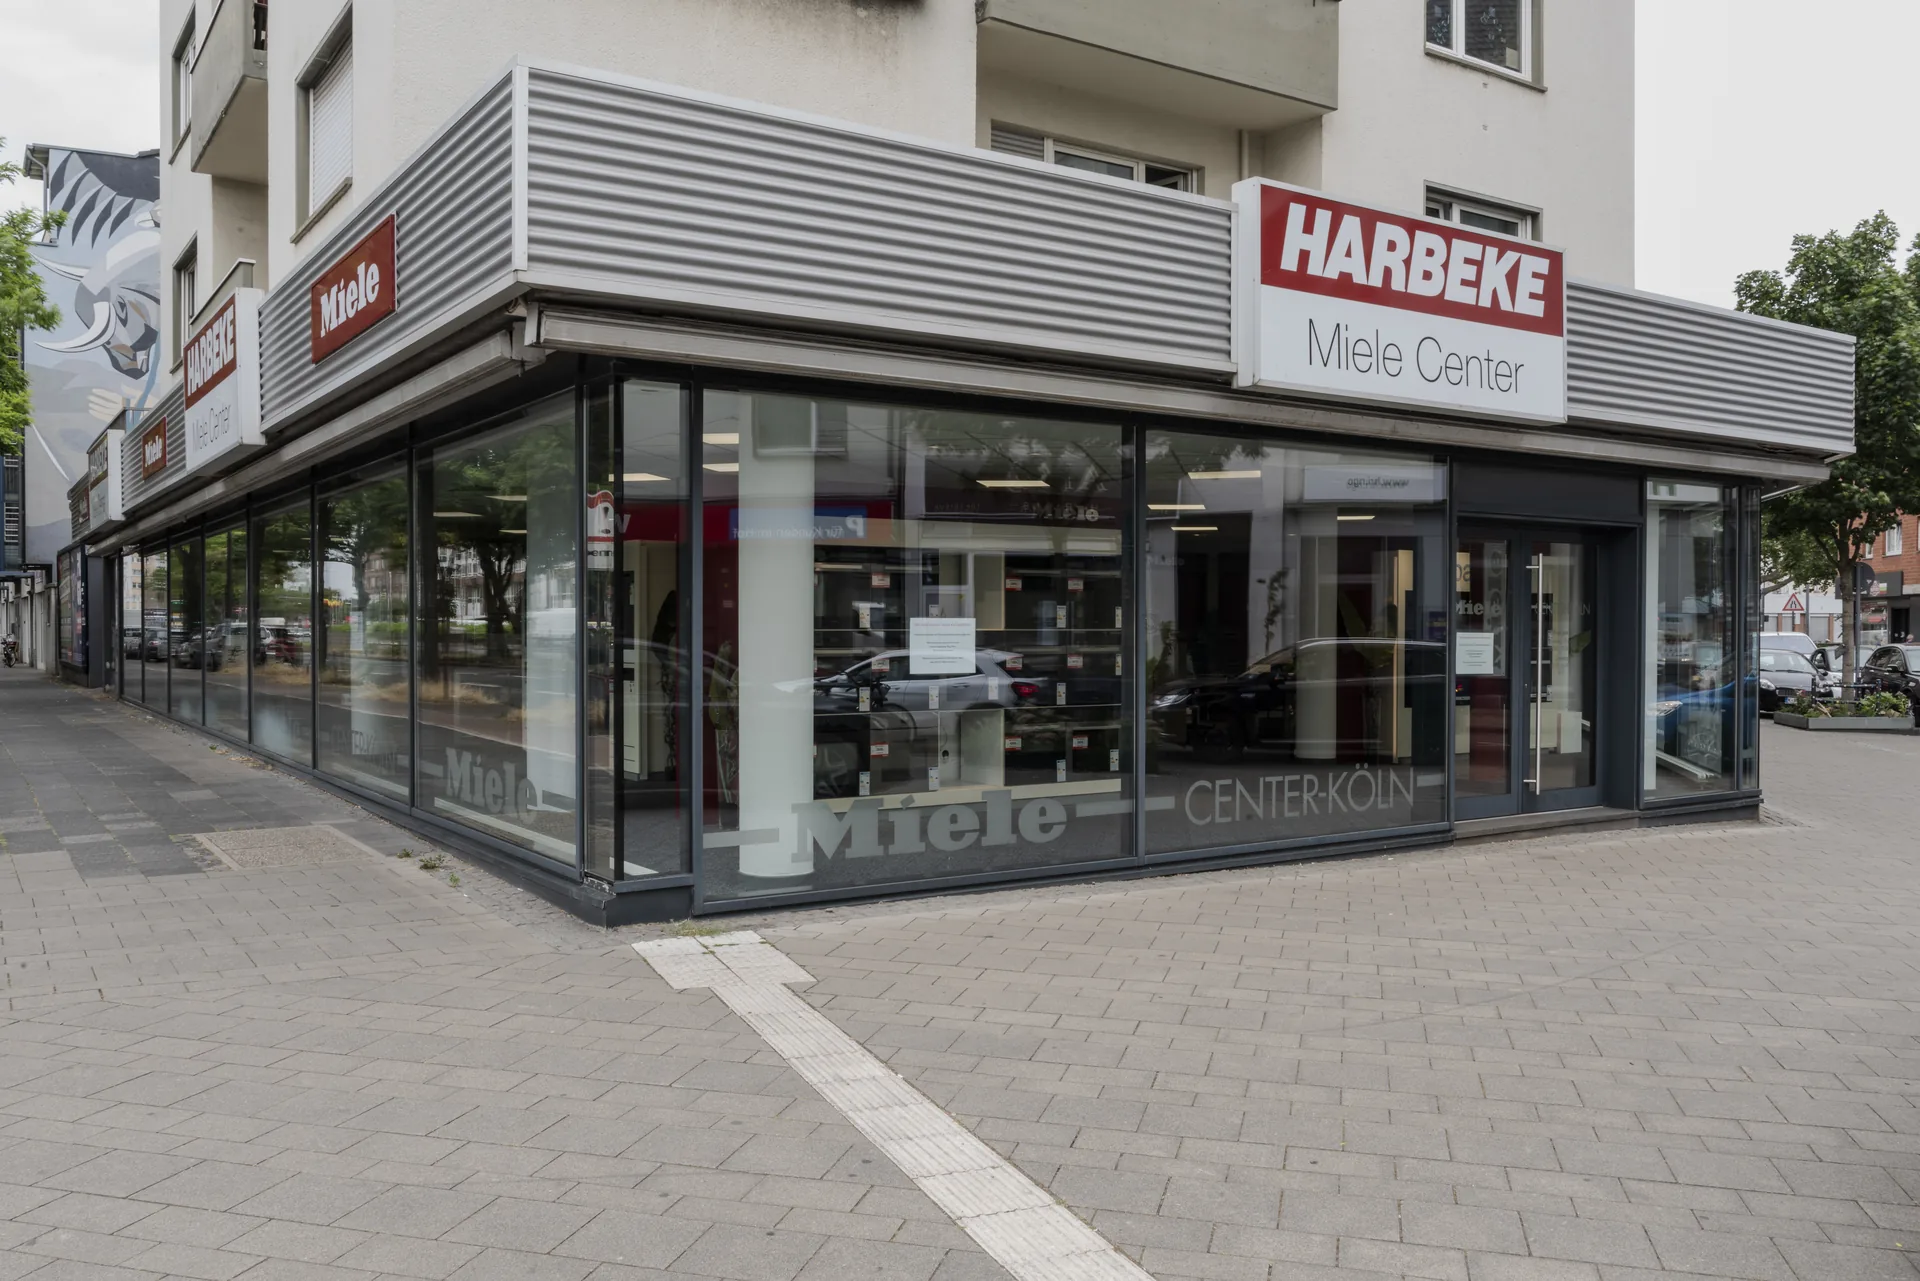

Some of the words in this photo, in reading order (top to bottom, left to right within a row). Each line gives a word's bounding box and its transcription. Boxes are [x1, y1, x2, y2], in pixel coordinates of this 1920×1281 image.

[320, 260, 380, 338] Miele
[1280, 202, 1550, 318] HARBEKE
[187, 303, 235, 397] HARBEKE
[1308, 318, 1403, 377] Miele
[1416, 336, 1525, 394] Center
[144, 434, 163, 468] Miele
[209, 404, 232, 444] Center
[445, 746, 538, 826] Miele
[791, 789, 1068, 864] Miele
[1184, 762, 1415, 826] CENTER-KÖLN
